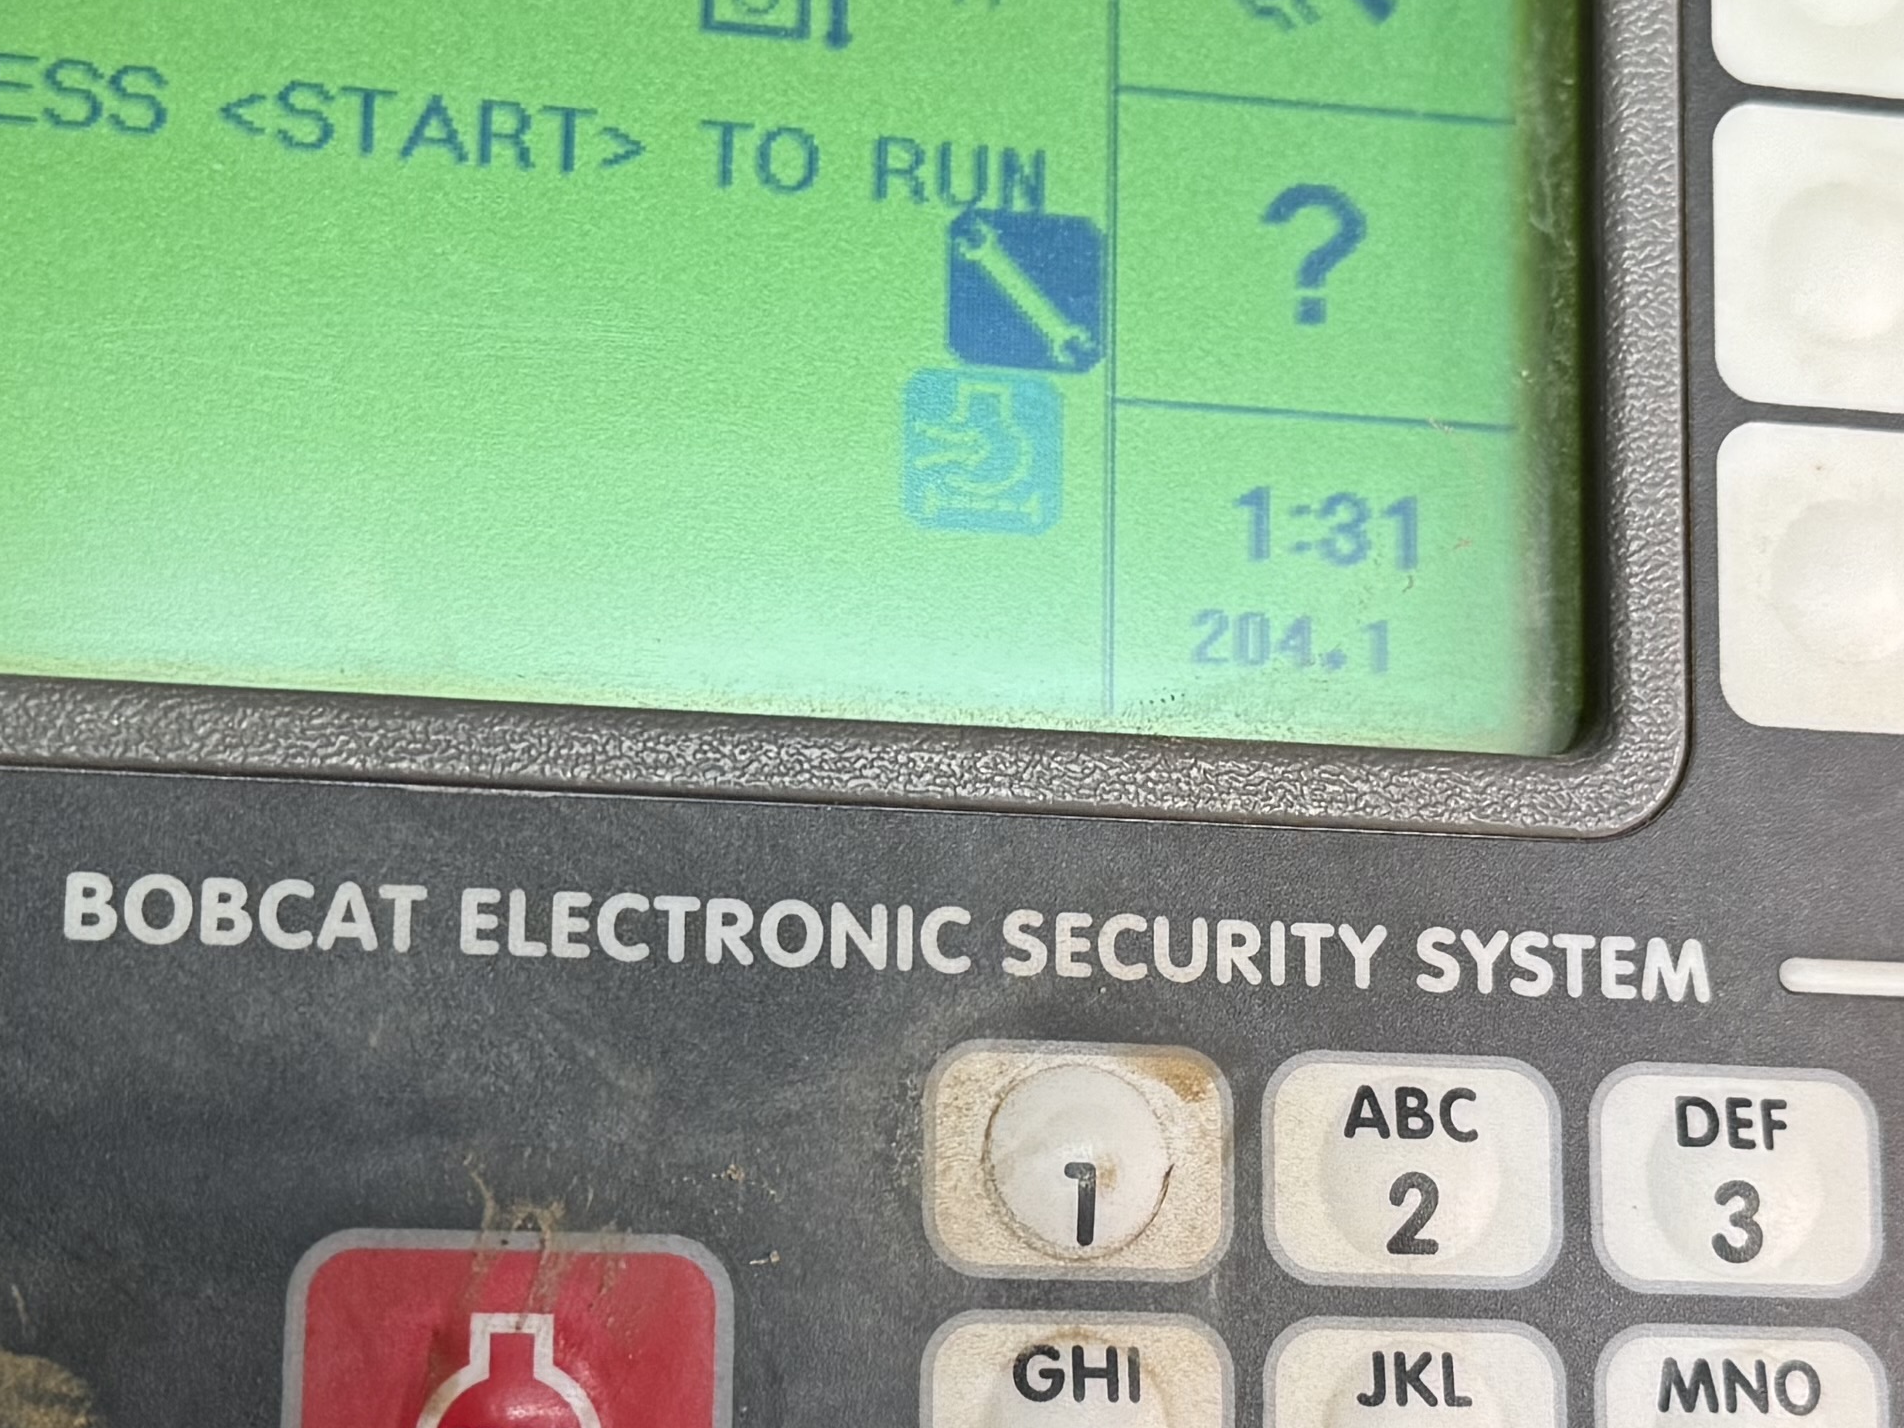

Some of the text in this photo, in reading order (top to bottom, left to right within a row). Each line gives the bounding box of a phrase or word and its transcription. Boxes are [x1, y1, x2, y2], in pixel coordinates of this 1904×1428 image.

[218, 79, 646, 174] <START>
[701, 117, 819, 194] TO
[873, 134, 1044, 212] RUN
[1233, 484, 1421, 570] 1:31
[1190, 606, 1392, 676] 204.1
[64, 871, 1713, 1004] BOBCAT ELECTRONIC SECURITY SYSTEM
[1344, 1084, 1480, 1144] ABC
[1678, 1095, 1789, 1152] DEF
[1062, 1162, 1099, 1248] 1
[1386, 1171, 1441, 1256] 2
[1712, 1182, 1766, 1264] 3
[1012, 1344, 1143, 1406] GHI
[1355, 1349, 1473, 1410] JKL
[1659, 1358, 1823, 1419] MNO
